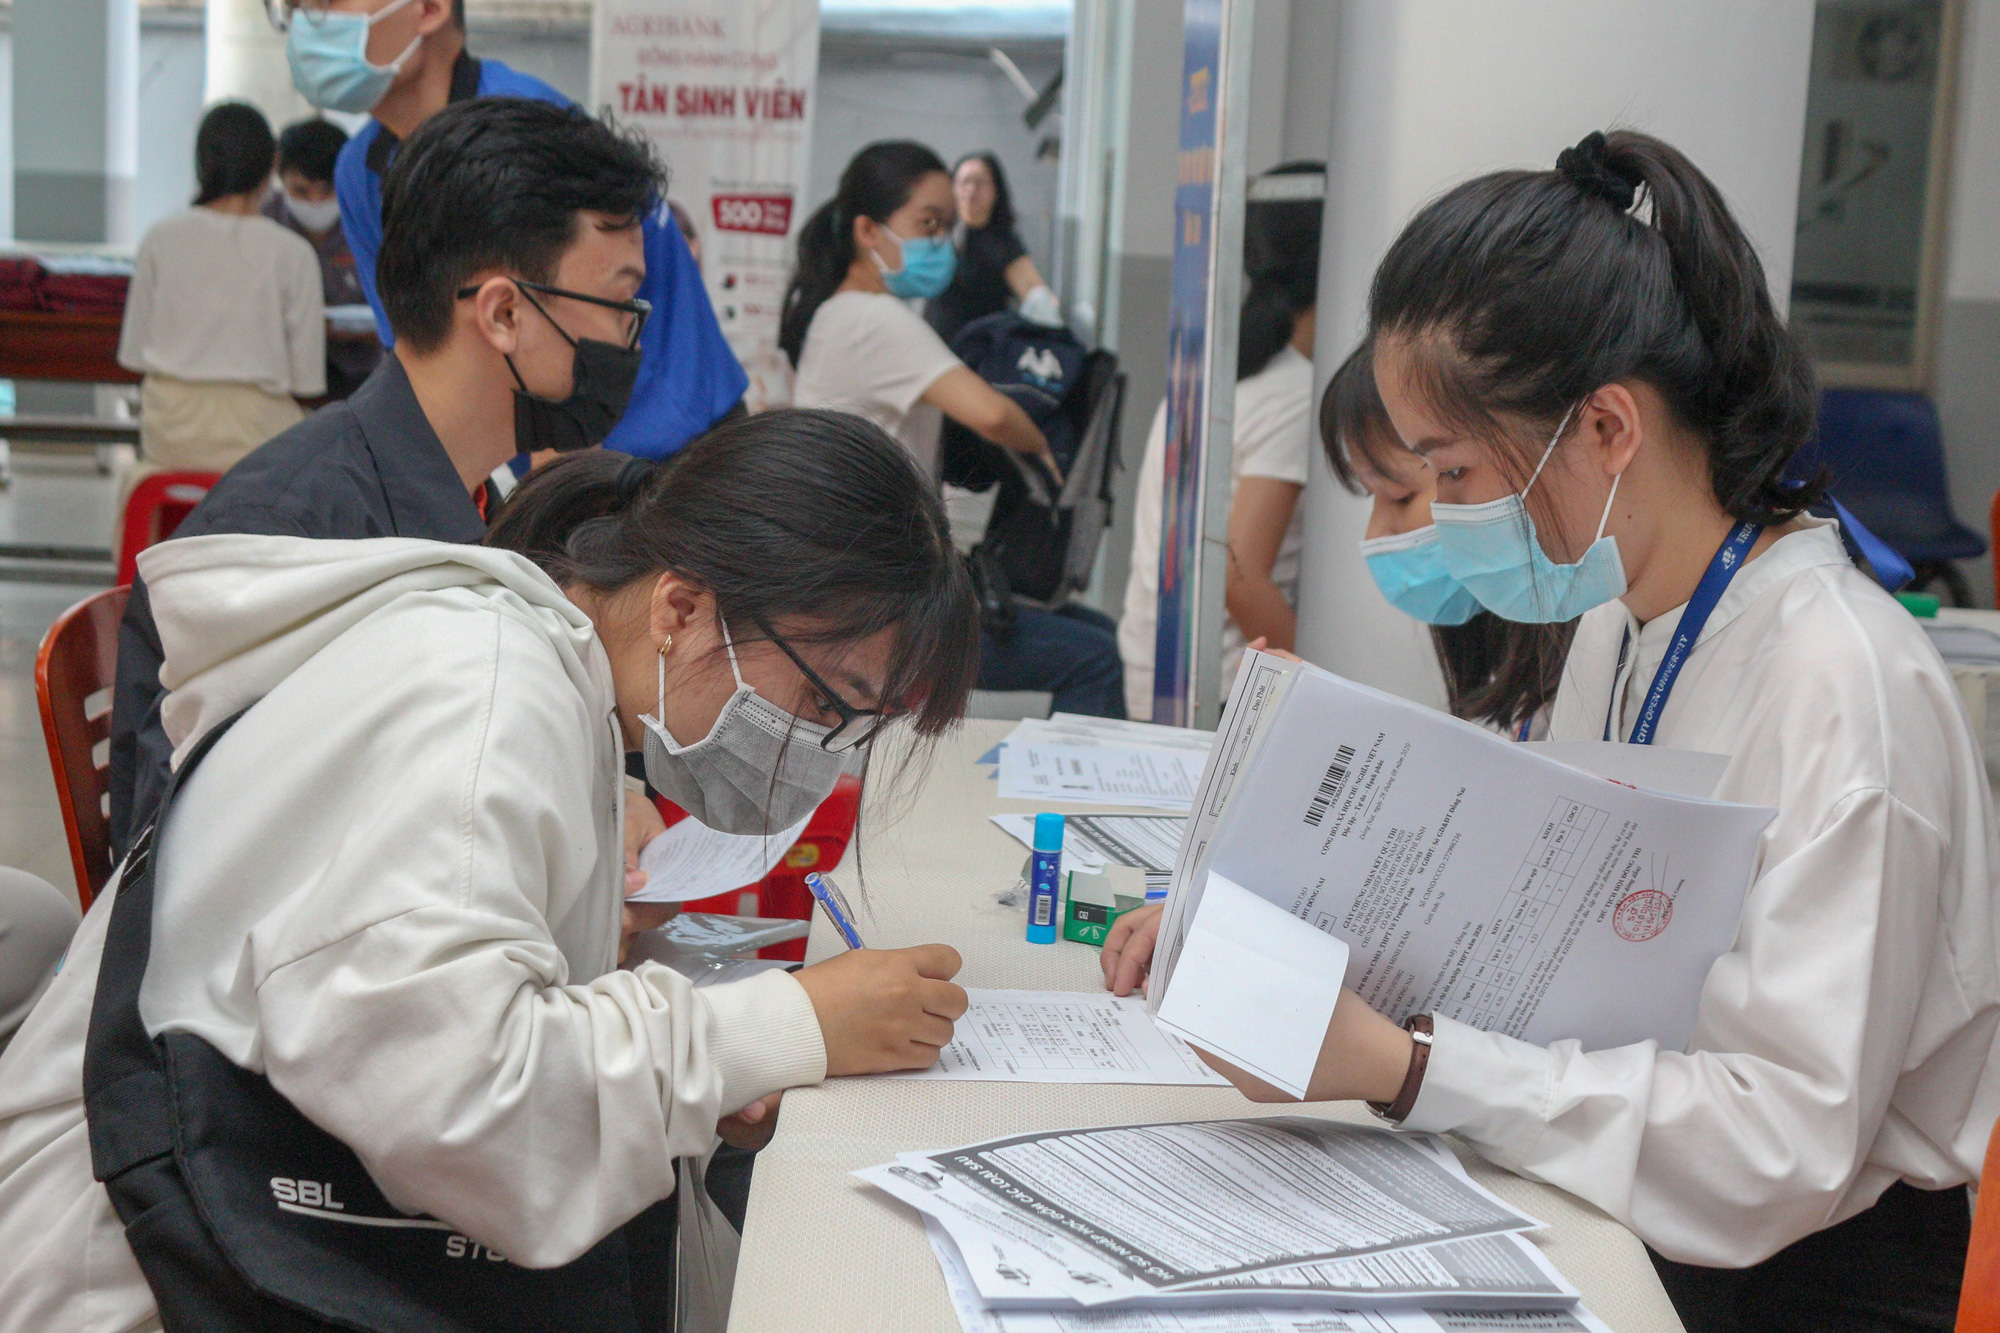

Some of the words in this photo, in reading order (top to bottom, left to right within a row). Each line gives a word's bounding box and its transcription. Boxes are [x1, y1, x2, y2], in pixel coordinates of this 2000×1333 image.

[619, 72, 668, 116] TÂN
[675, 82, 736, 119] SINH
[744, 77, 806, 121] VIÊN
[1637, 720, 1651, 745] CITY
[1646, 692, 1661, 720] OPEN
[1657, 633, 1689, 693] UNIVERSITY
[1373, 731, 1385, 748] NAM
[1365, 747, 1378, 764] VIỆT
[1353, 762, 1370, 785] NGHĨA
[1373, 758, 1385, 773] phúc
[1365, 772, 1377, 790] Hạnh
[1346, 783, 1359, 800] CHỦ
[1358, 793, 1367, 802] do
[1341, 798, 1353, 812] HỘI
[1354, 801, 1364, 812] Tự
[1335, 810, 1346, 822] XÃ
[1347, 815, 1357, 826] lập
[1328, 820, 1341, 837] HÒA
[1341, 824, 1352, 837] Độc
[1416, 866, 1425, 875] Sở
[1432, 837, 1440, 846] Sở
[1436, 812, 1453, 838] GD&ĐT
[1447, 796, 1461, 813] Đồng
[1457, 786, 1466, 798] Nai
[1542, 822, 1554, 840] KHXH
[1319, 835, 1334, 856] CỘNG
[1341, 910, 1355, 929] GIẤY
[1349, 887, 1367, 912] CHỨNG
[1362, 867, 1377, 888] NHẬN
[1372, 854, 1384, 869] KẾT
[1379, 839, 1392, 856] QUẢ
[1387, 826, 1399, 841] THI
[1348, 920, 1358, 933] KỲ
[1354, 910, 1364, 922] THI
[1359, 898, 1370, 911] TỐT
[1366, 874, 1383, 899] NGHIỆP
[1378, 858, 1391, 875] THPT
[1386, 842, 1399, 859] NĂM
[1395, 828, 1406, 843] 2020
[1356, 923, 1367, 937] HỘI
[1362, 905, 1376, 924] ĐỒNG
[1372, 893, 1382, 906] THI
[1382, 861, 1399, 885] GD&ĐT
[1393, 842, 1408, 863] ĐỒNG
[1404, 831, 1415, 844] NAI
[1359, 923, 1376, 948] CHỨNG
[1371, 905, 1386, 925] NHẬN
[1381, 892, 1393, 907] KẾT
[1388, 878, 1400, 894] QUẢ
[1395, 866, 1406, 879] THI
[1401, 852, 1413, 868] CHO
[1407, 840, 1419, 854] THÍ
[1414, 825, 1428, 842] SINH
[1595, 907, 1608, 923] CHỦ
[1604, 891, 1617, 908] TỊCH
[1613, 878, 1624, 892] HỘI
[1619, 858, 1635, 879] ĐỒNG
[1631, 846, 1641, 860] THI
[1305, 888, 1319, 907] ĐỒNG
[1315, 876, 1325, 889] NAI
[953, 1155, 983, 1171] SAU
[978, 1170, 1011, 1189] LOẠI
[270, 1176, 345, 1210] SBL
[1005, 1187, 1034, 1204] CÁC
[1145, 1266, 1176, 1281] HỒ
